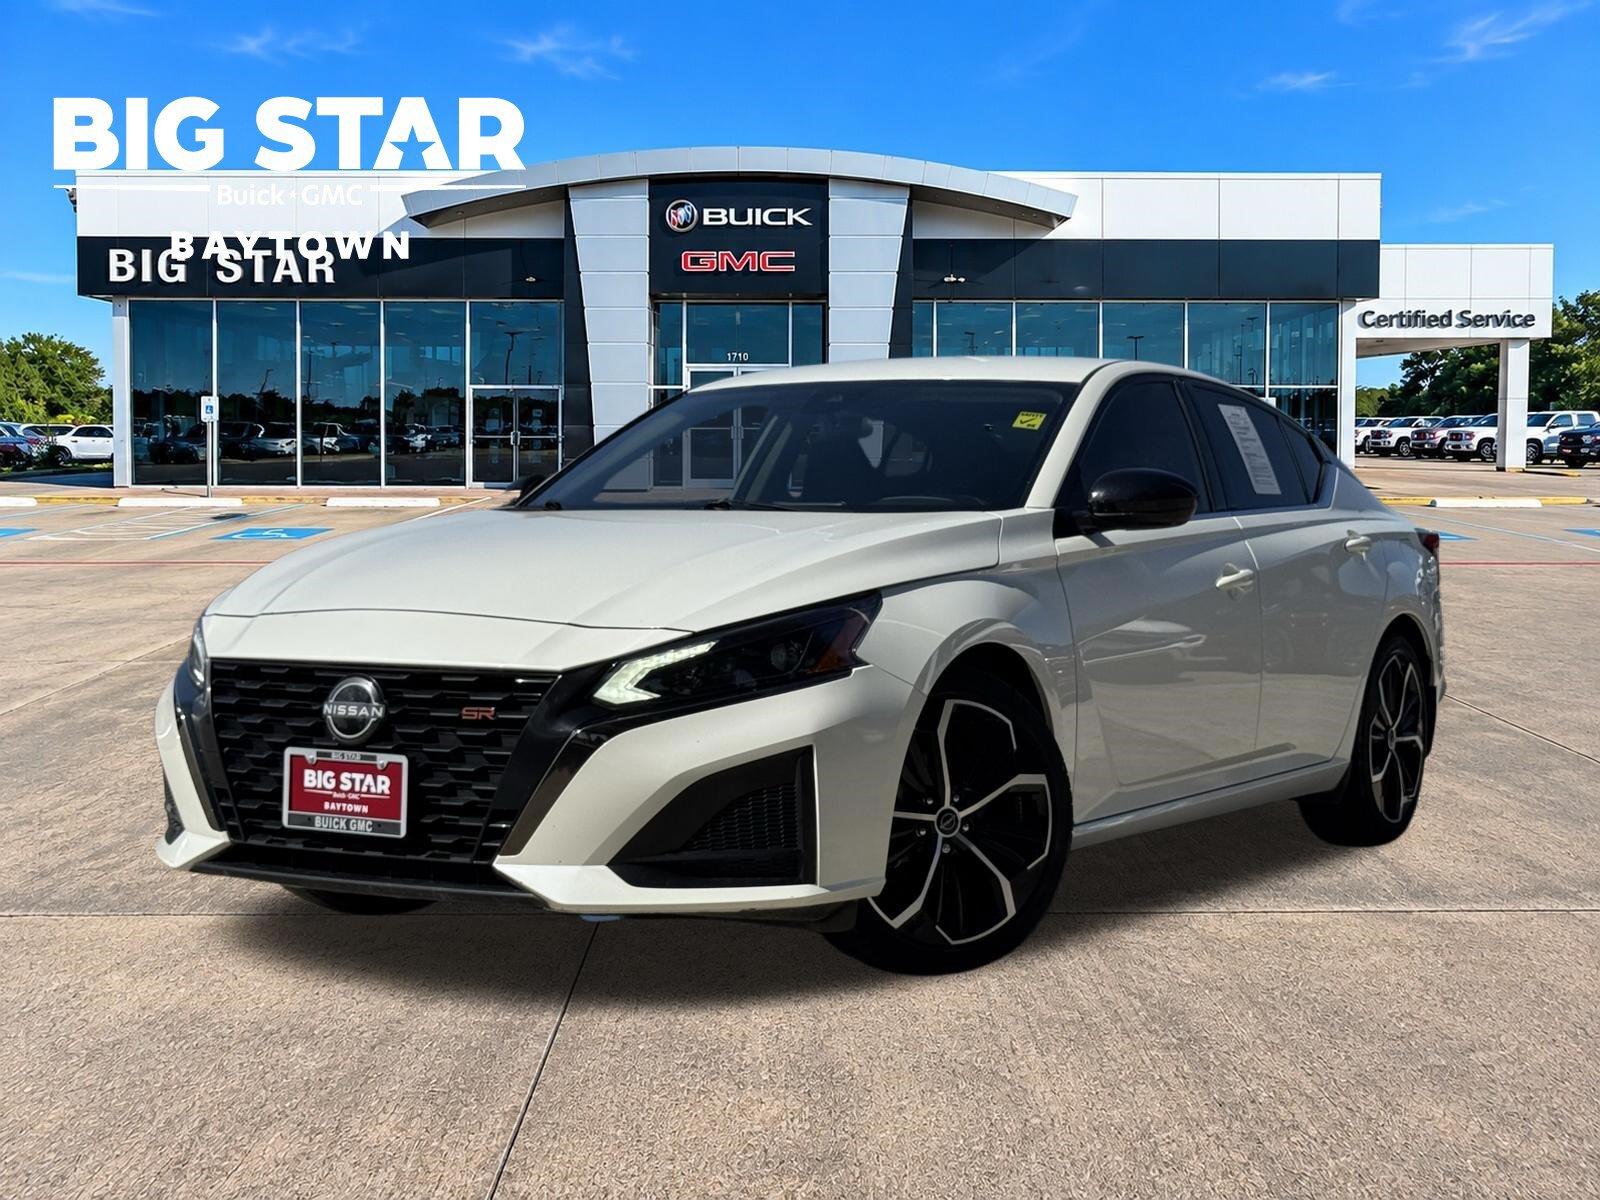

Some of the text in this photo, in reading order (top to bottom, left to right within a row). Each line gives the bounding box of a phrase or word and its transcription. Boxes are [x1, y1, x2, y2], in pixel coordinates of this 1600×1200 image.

[703, 208, 813, 226] BUICK
[108, 249, 336, 284] BIG STAR
[681, 251, 796, 272] GMC
[1359, 310, 1536, 329] Certified Service
[727, 352, 749, 361] 1710
[323, 703, 384, 718] NISSAN
[462, 707, 496, 720] SR
[303, 768, 391, 795] BIG STAR
[323, 801, 369, 814] BAYTOWN
[314, 815, 373, 832] BUICK GMC
